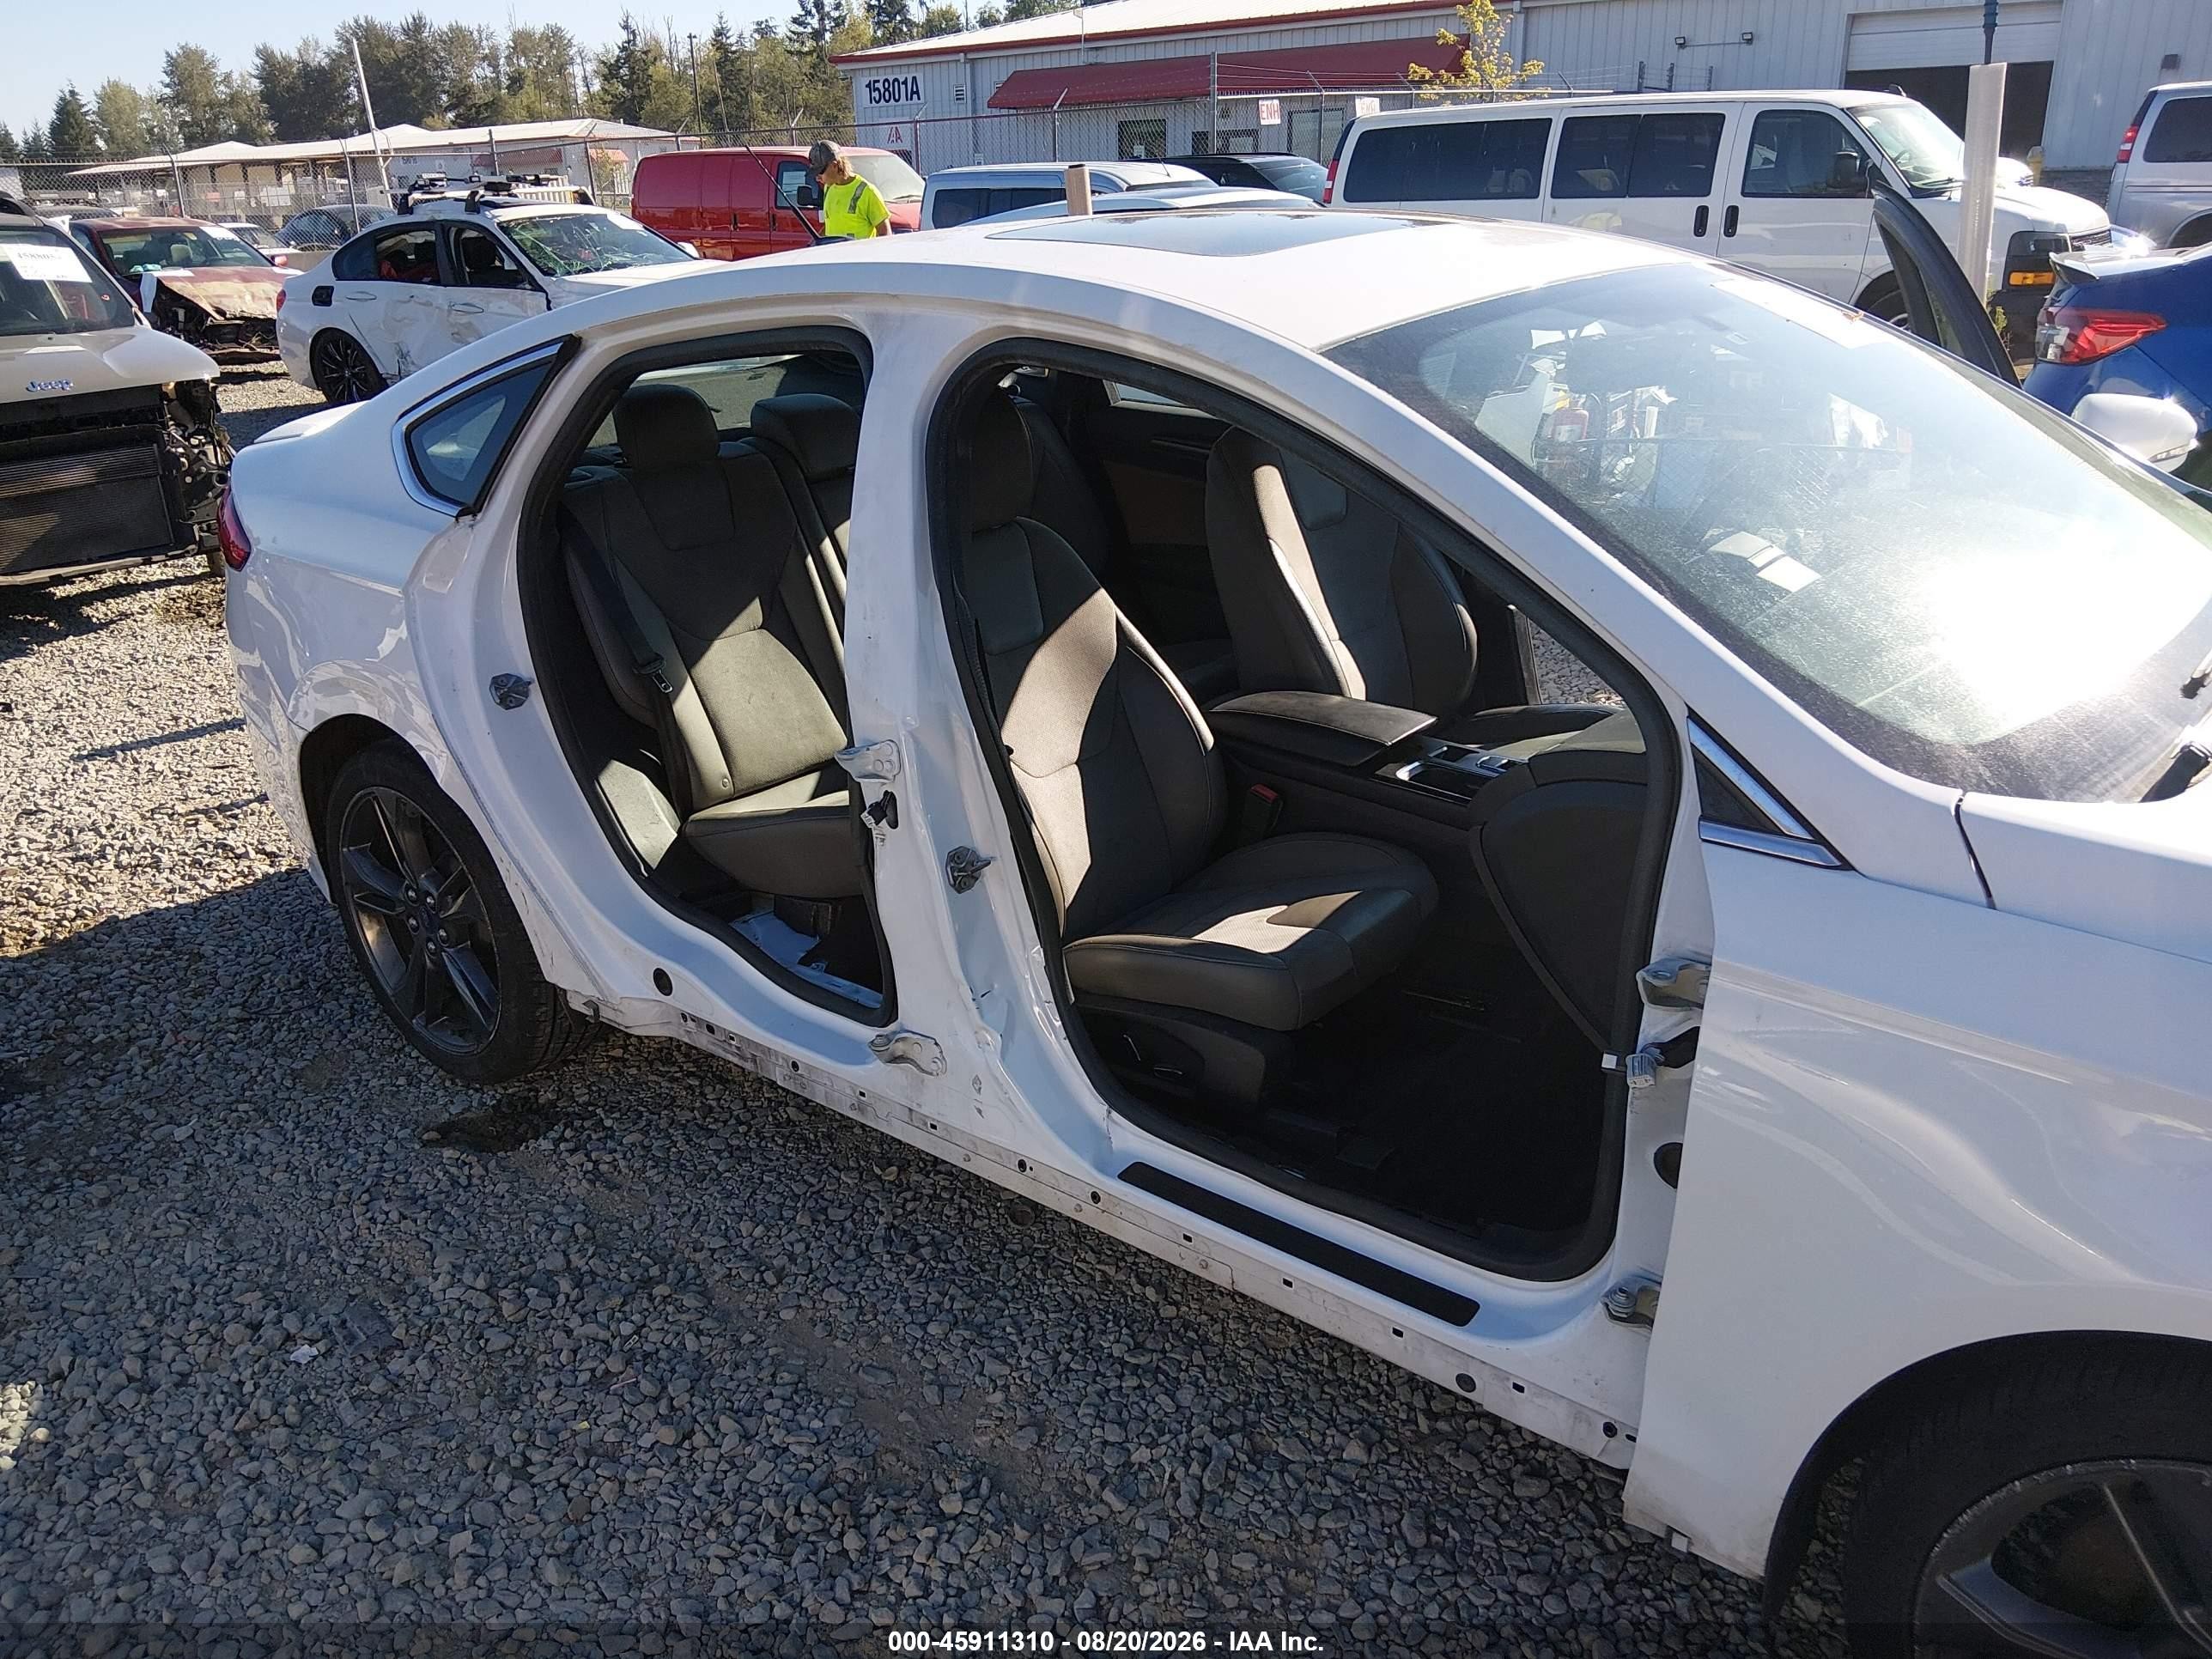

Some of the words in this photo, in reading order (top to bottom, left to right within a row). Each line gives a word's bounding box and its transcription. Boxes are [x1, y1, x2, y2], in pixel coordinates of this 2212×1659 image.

[865, 76, 921, 104] 15801A
[1260, 103, 1279, 120] ENH
[26, 380, 72, 392] Jeep
